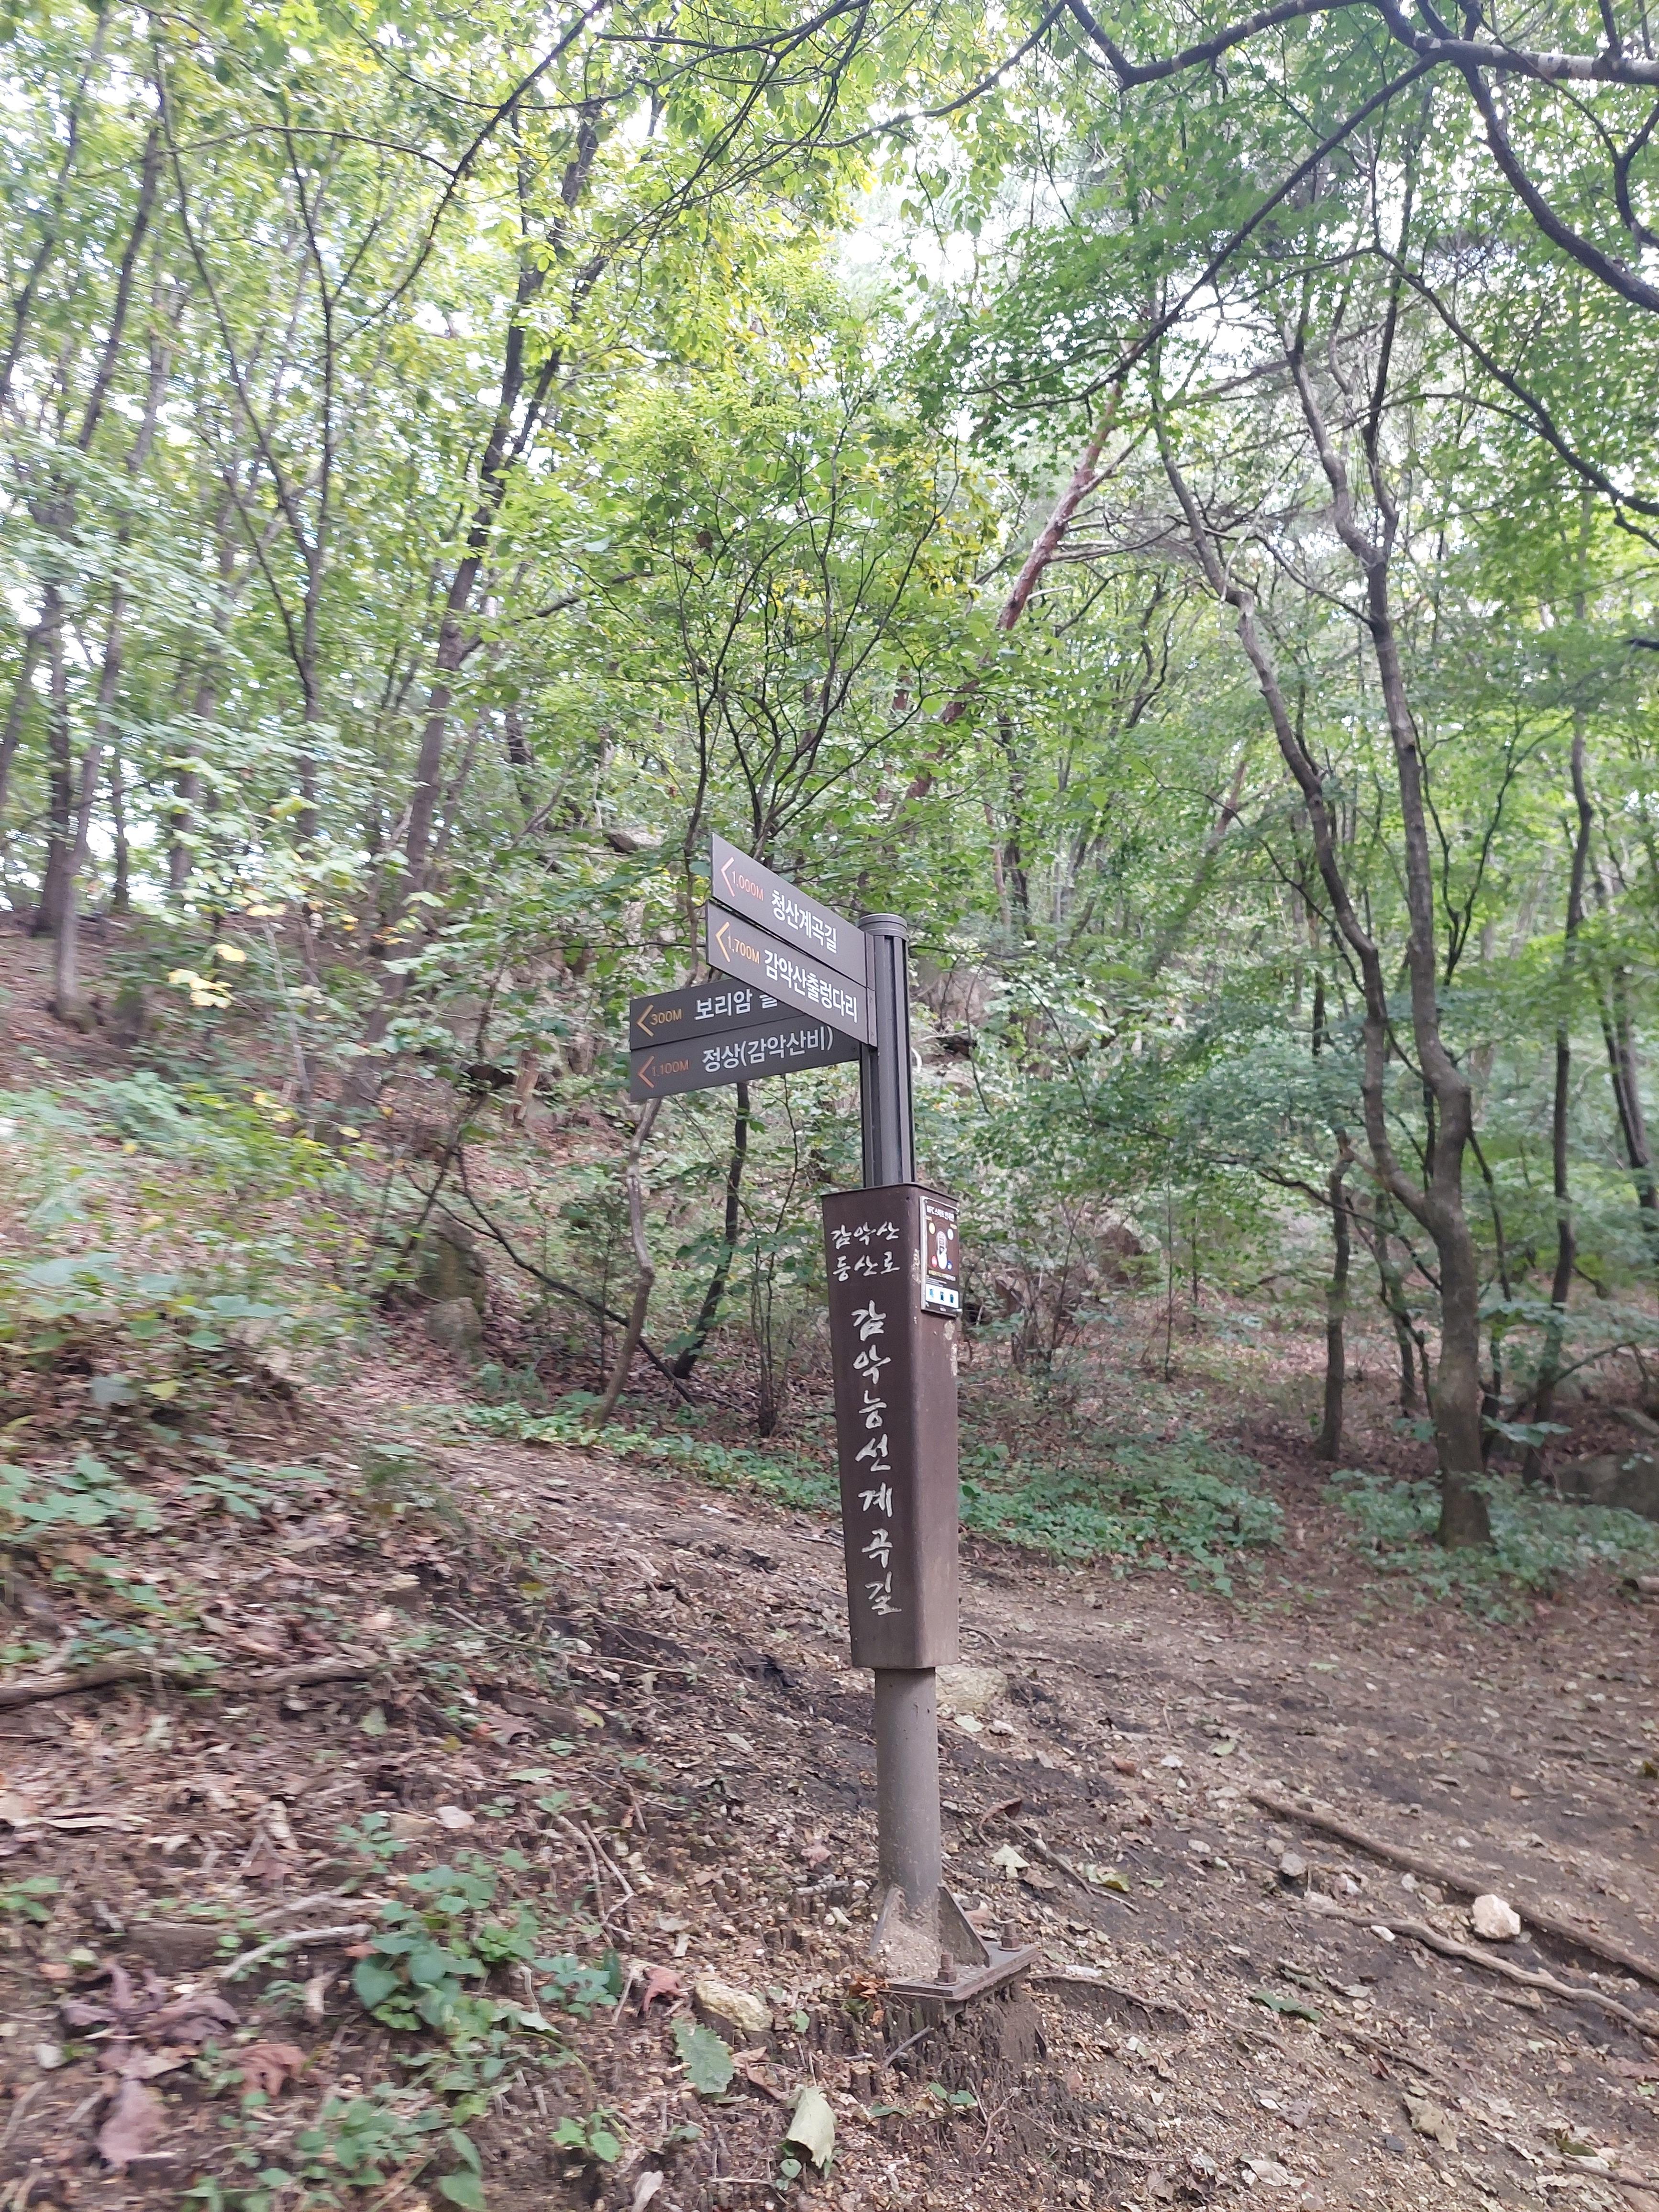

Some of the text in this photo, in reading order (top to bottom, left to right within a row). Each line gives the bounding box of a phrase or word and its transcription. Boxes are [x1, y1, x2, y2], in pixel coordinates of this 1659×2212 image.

[771, 889, 837, 954] 청산계곡길
[764, 949, 857, 1023] 감악산출렁다리
[650, 1008, 683, 1026] 300M
[694, 988, 753, 1020] 보리암
[702, 1026, 834, 1073] 정상(감악산비)
[830, 1221, 900, 1250] 감악산
[832, 1251, 901, 1282] 등산로
